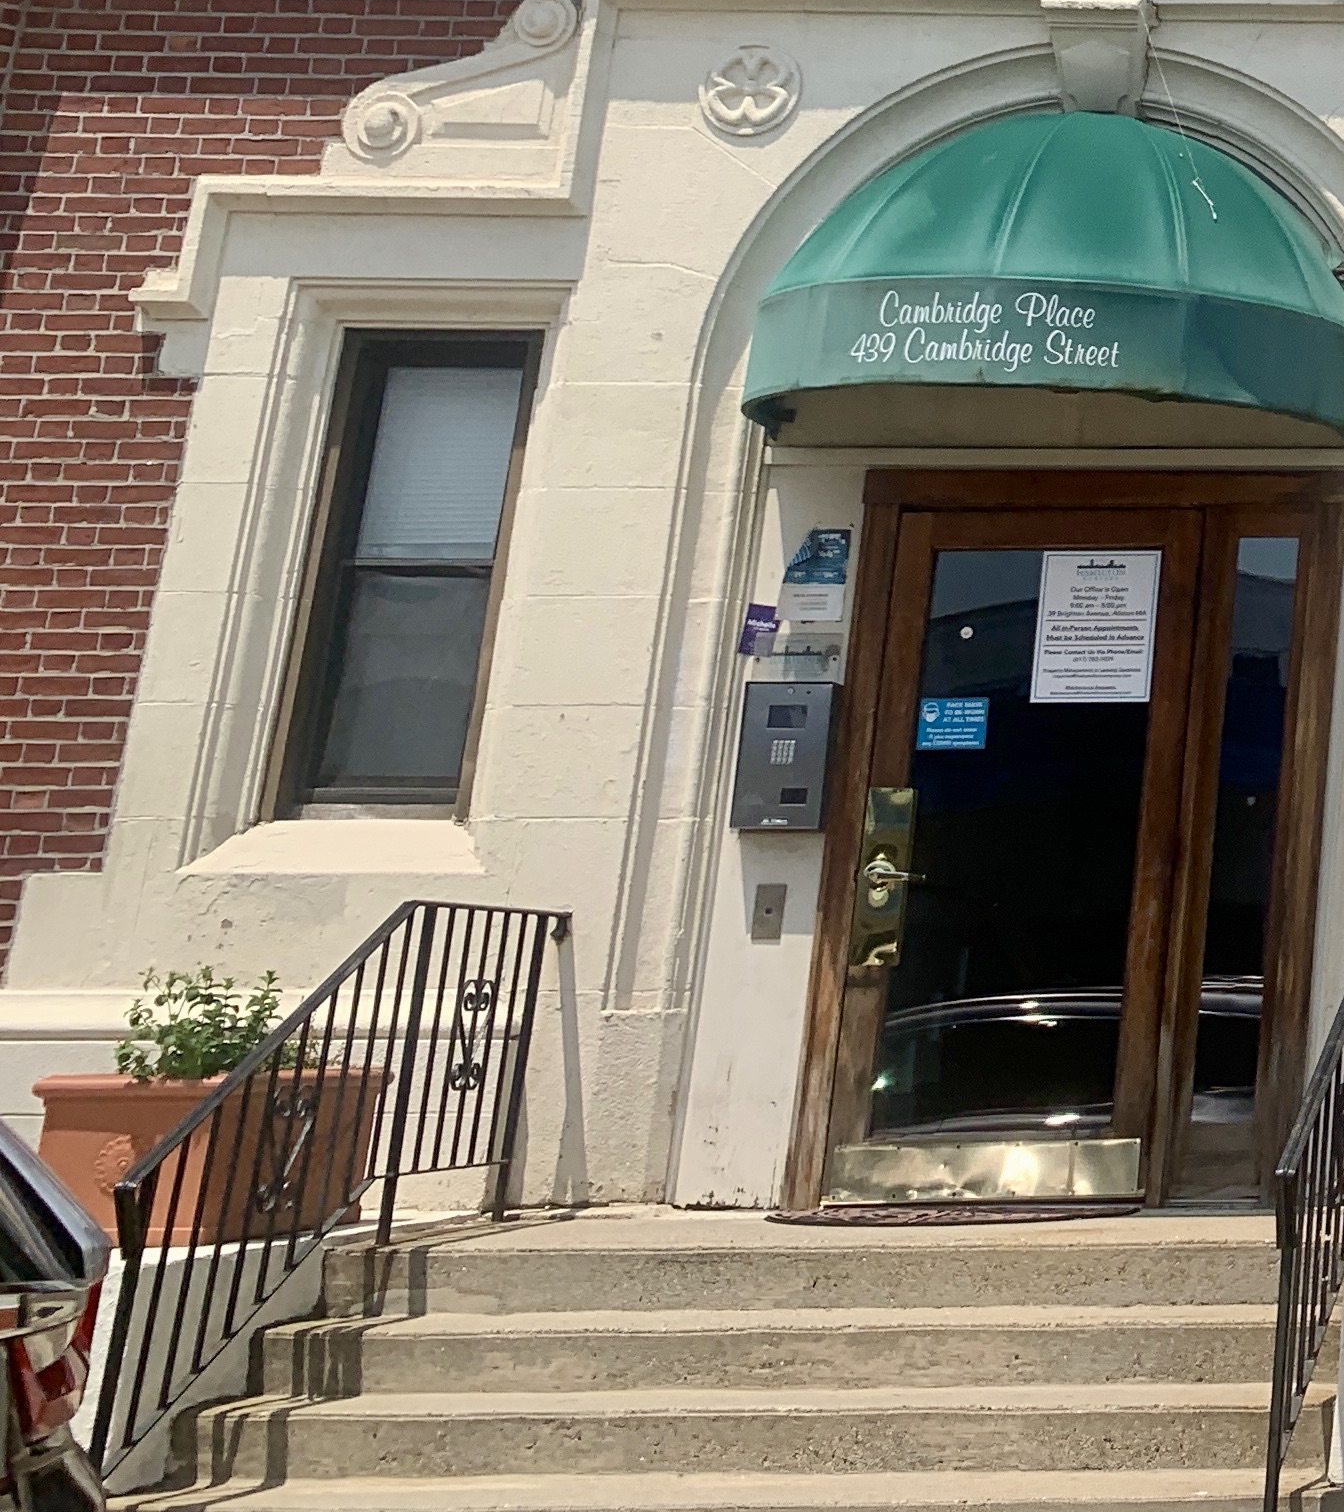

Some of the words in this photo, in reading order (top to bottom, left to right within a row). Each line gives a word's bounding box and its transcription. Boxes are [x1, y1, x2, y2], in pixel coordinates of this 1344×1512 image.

[879, 290, 1003, 334] Cambridge
[1014, 292, 1096, 329] Place
[850, 332, 896, 363] 439
[904, 327, 1034, 372] Cambridge
[1043, 329, 1120, 368] Street
